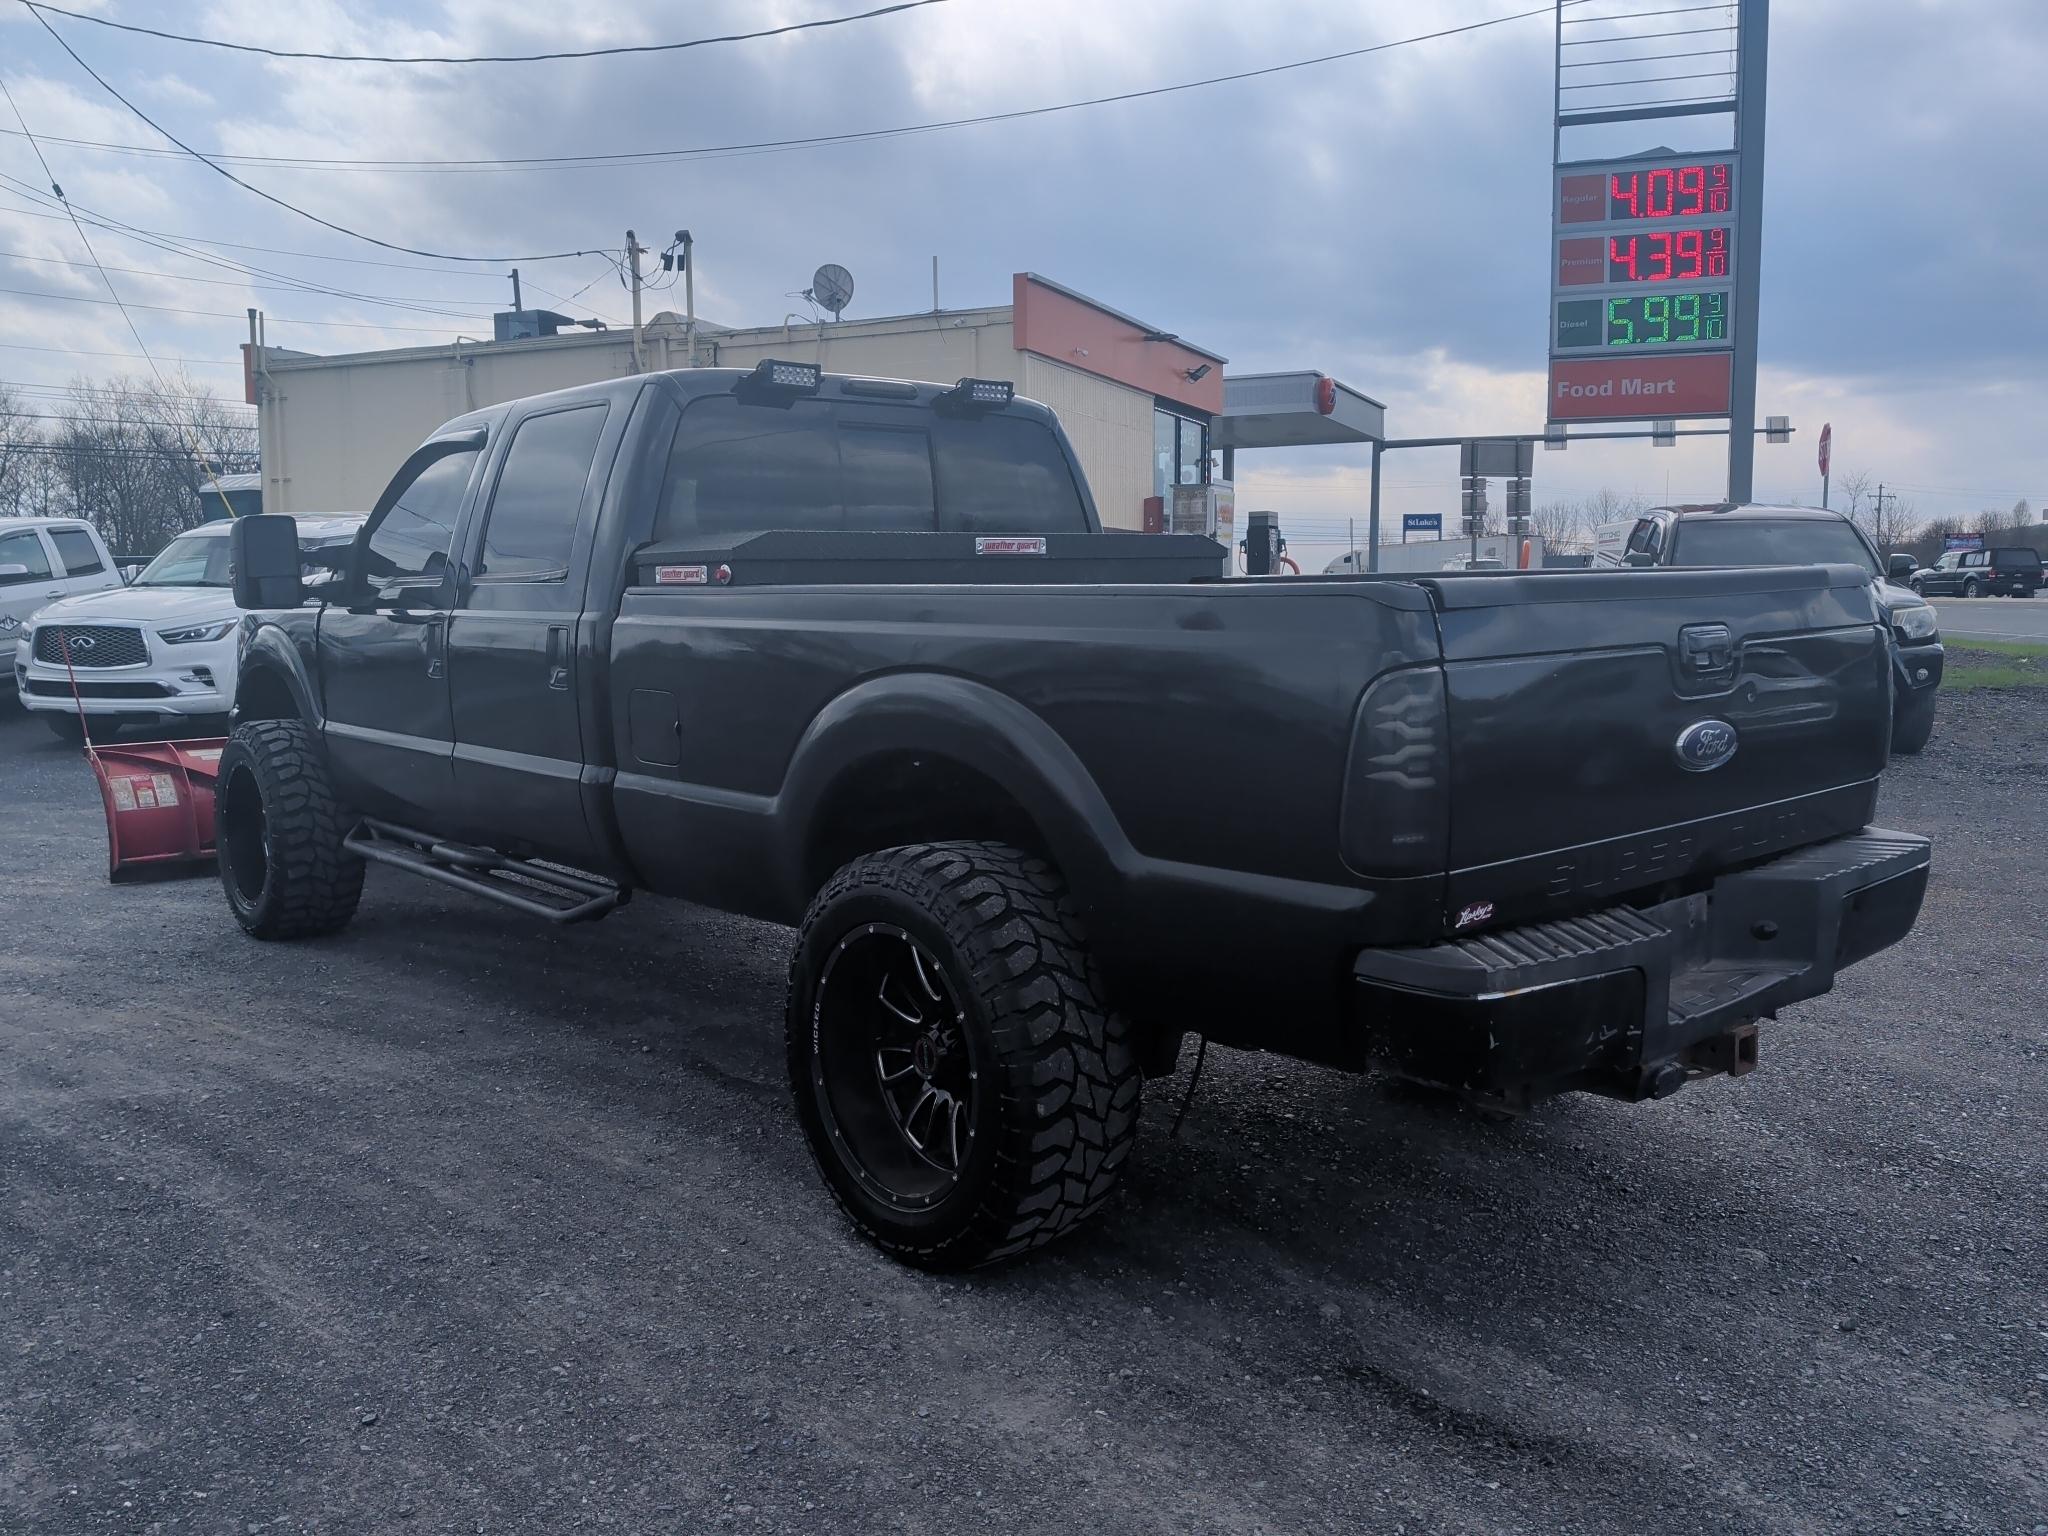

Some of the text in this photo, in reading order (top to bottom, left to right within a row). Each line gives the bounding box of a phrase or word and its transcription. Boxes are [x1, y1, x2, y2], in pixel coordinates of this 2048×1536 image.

[1611, 166, 1705, 217] 4.09
[1561, 257, 1602, 266] Premium
[1610, 230, 1703, 280] 4.39
[1560, 319, 1588, 329] Diesel
[1608, 294, 1700, 345] 5.99
[1557, 378, 1676, 398] Food Mart
[984, 541, 1038, 551] weather guard
[1697, 729, 1728, 756] Ford
